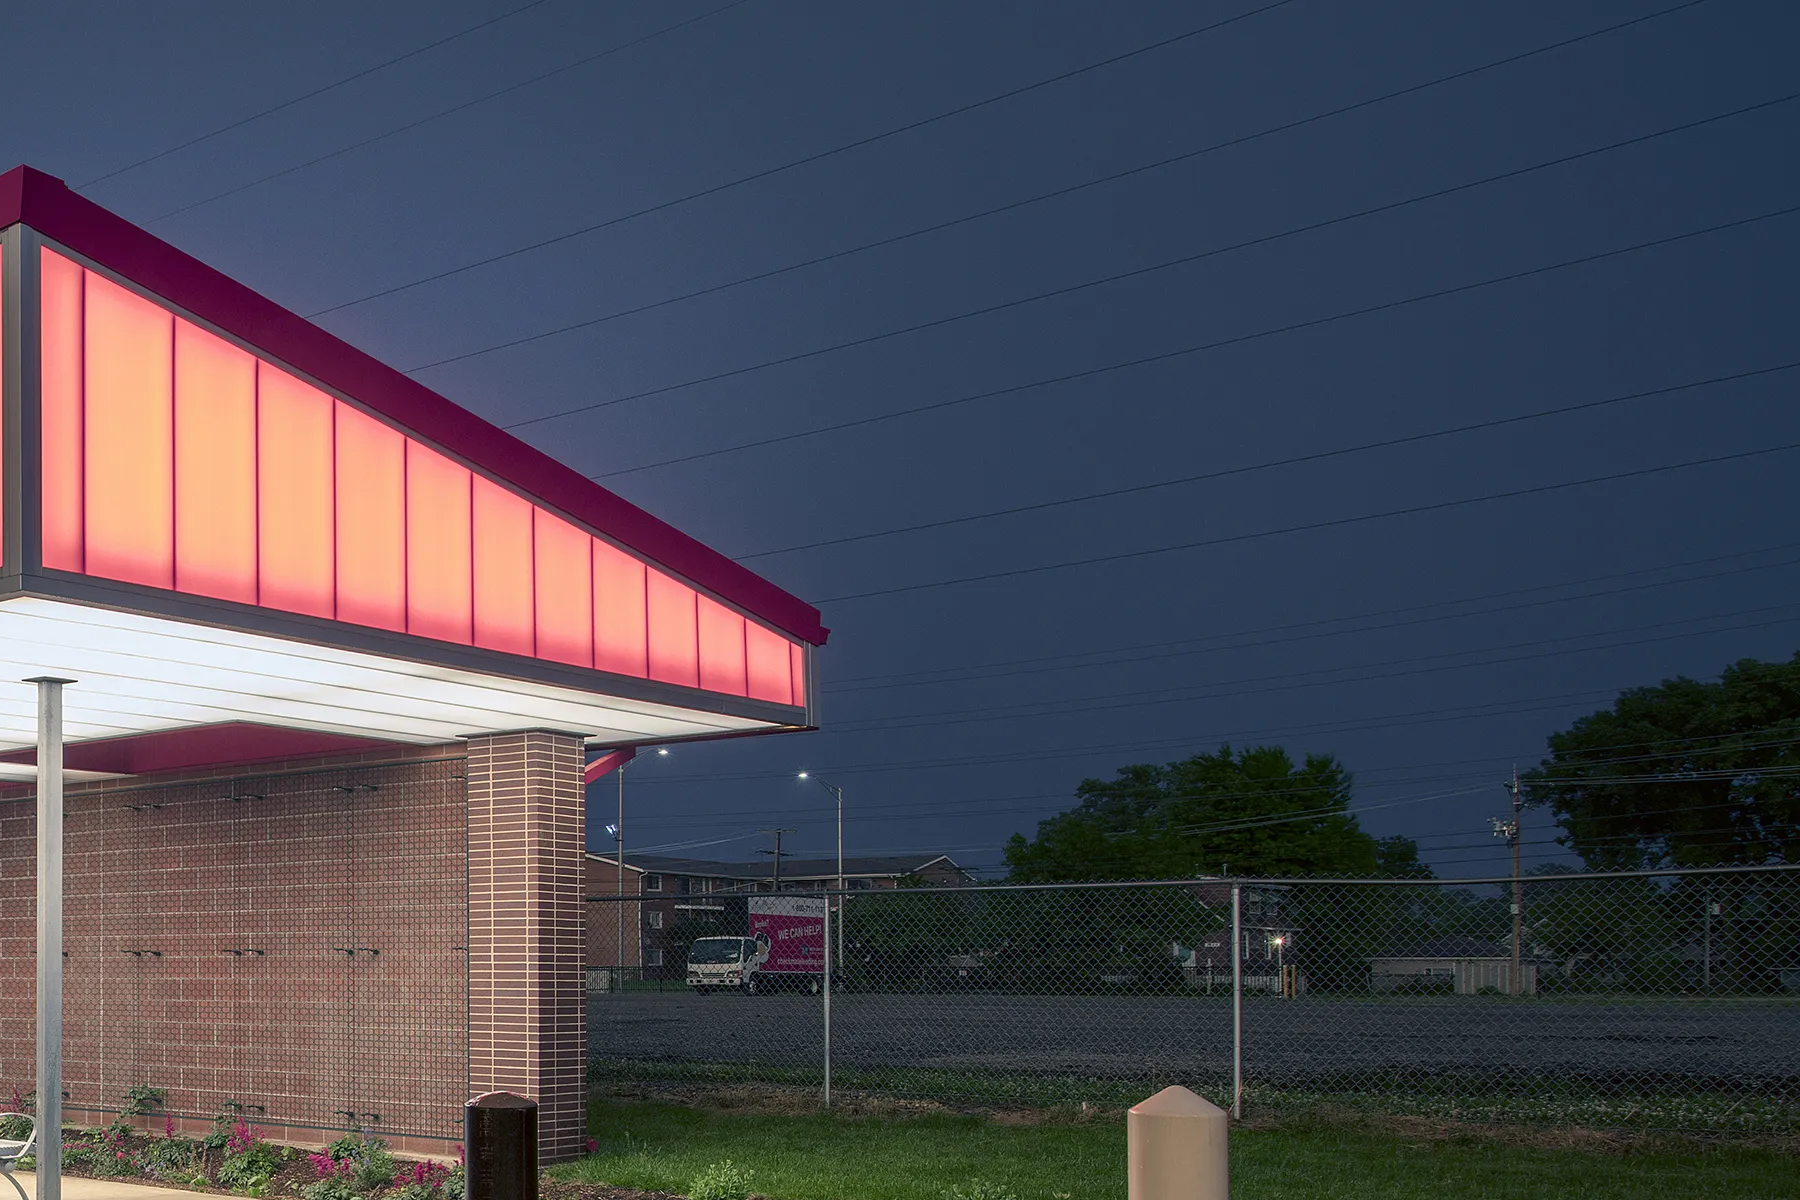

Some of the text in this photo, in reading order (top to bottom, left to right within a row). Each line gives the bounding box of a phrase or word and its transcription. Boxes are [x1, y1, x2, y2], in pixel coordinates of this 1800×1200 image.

[777, 924, 822, 940] WE CAN HELP!
